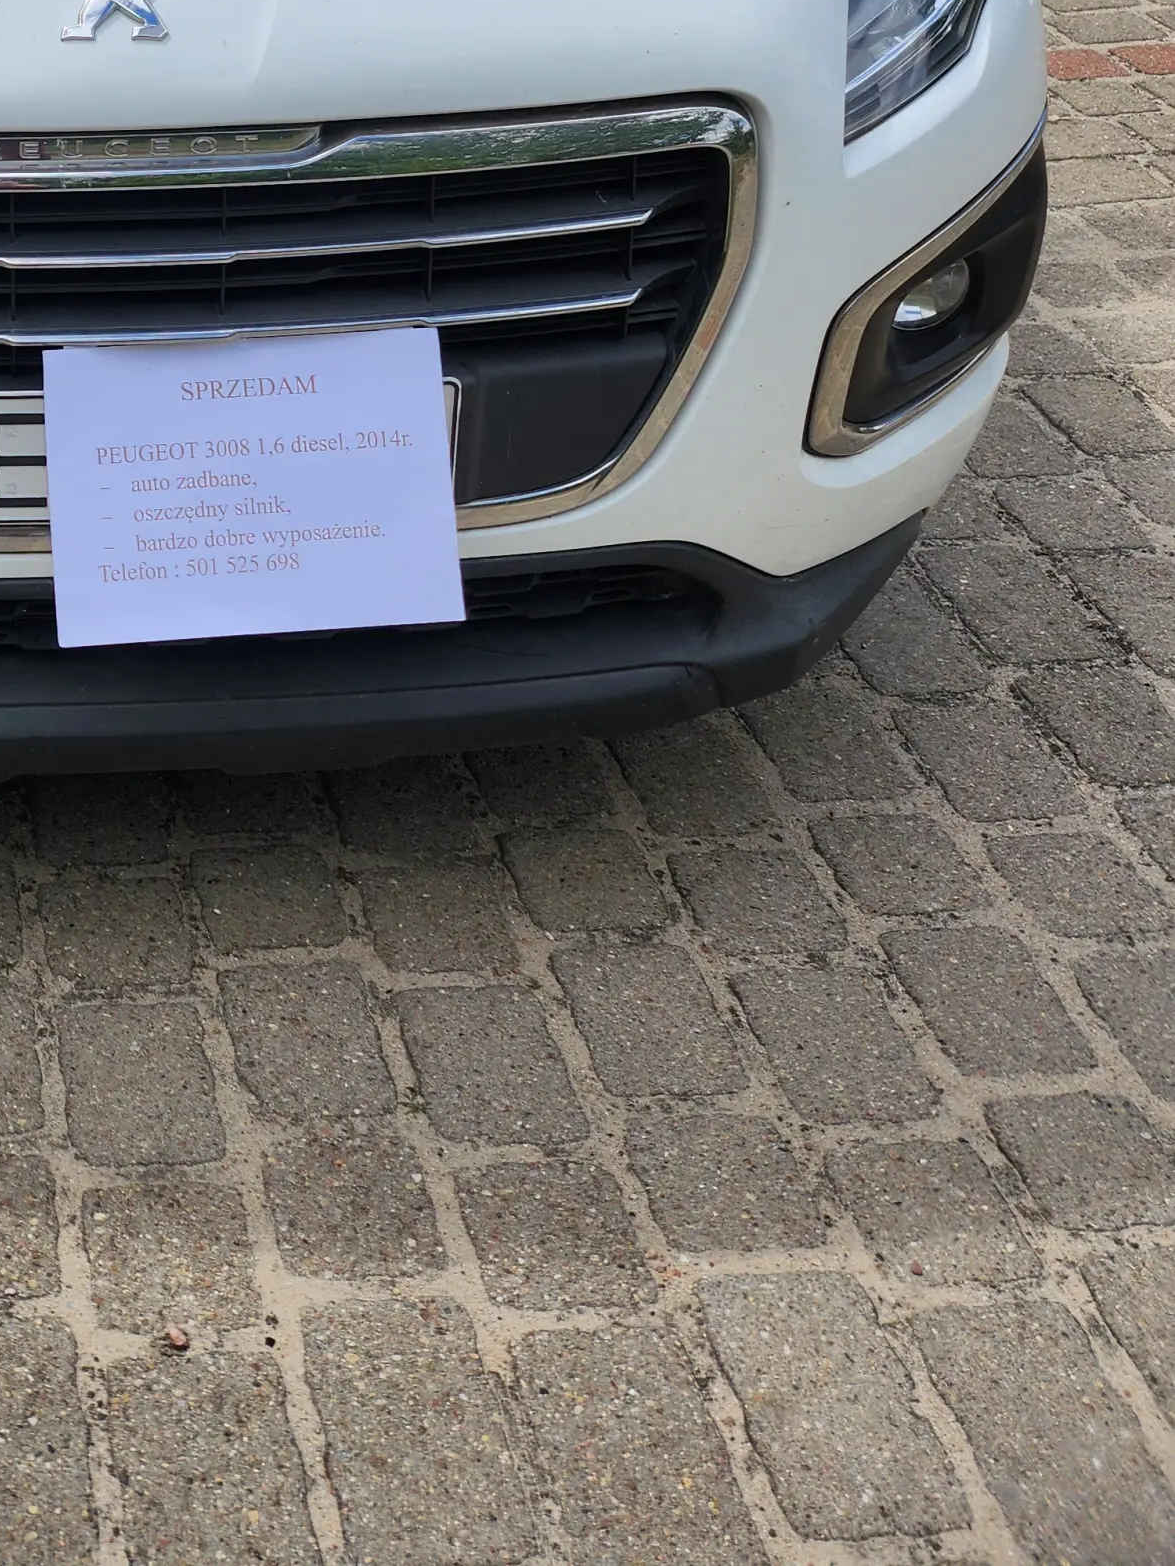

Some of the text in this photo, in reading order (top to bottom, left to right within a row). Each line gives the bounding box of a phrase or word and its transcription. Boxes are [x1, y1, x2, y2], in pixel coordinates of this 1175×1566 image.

[180, 374, 318, 401] SPRZEDAM
[95, 429, 414, 465] PEUGEOT 3008 1,6 diesel, 2014r.
[131, 469, 258, 493] auto zadbane,
[133, 495, 292, 524] oszczędny silnik,
[135, 521, 386, 553] bardzo dobre wyposażenie.
[98, 563, 168, 584] Telefon
[186, 557, 218, 577] 501
[226, 554, 260, 574] 525
[266, 552, 300, 572] 698
